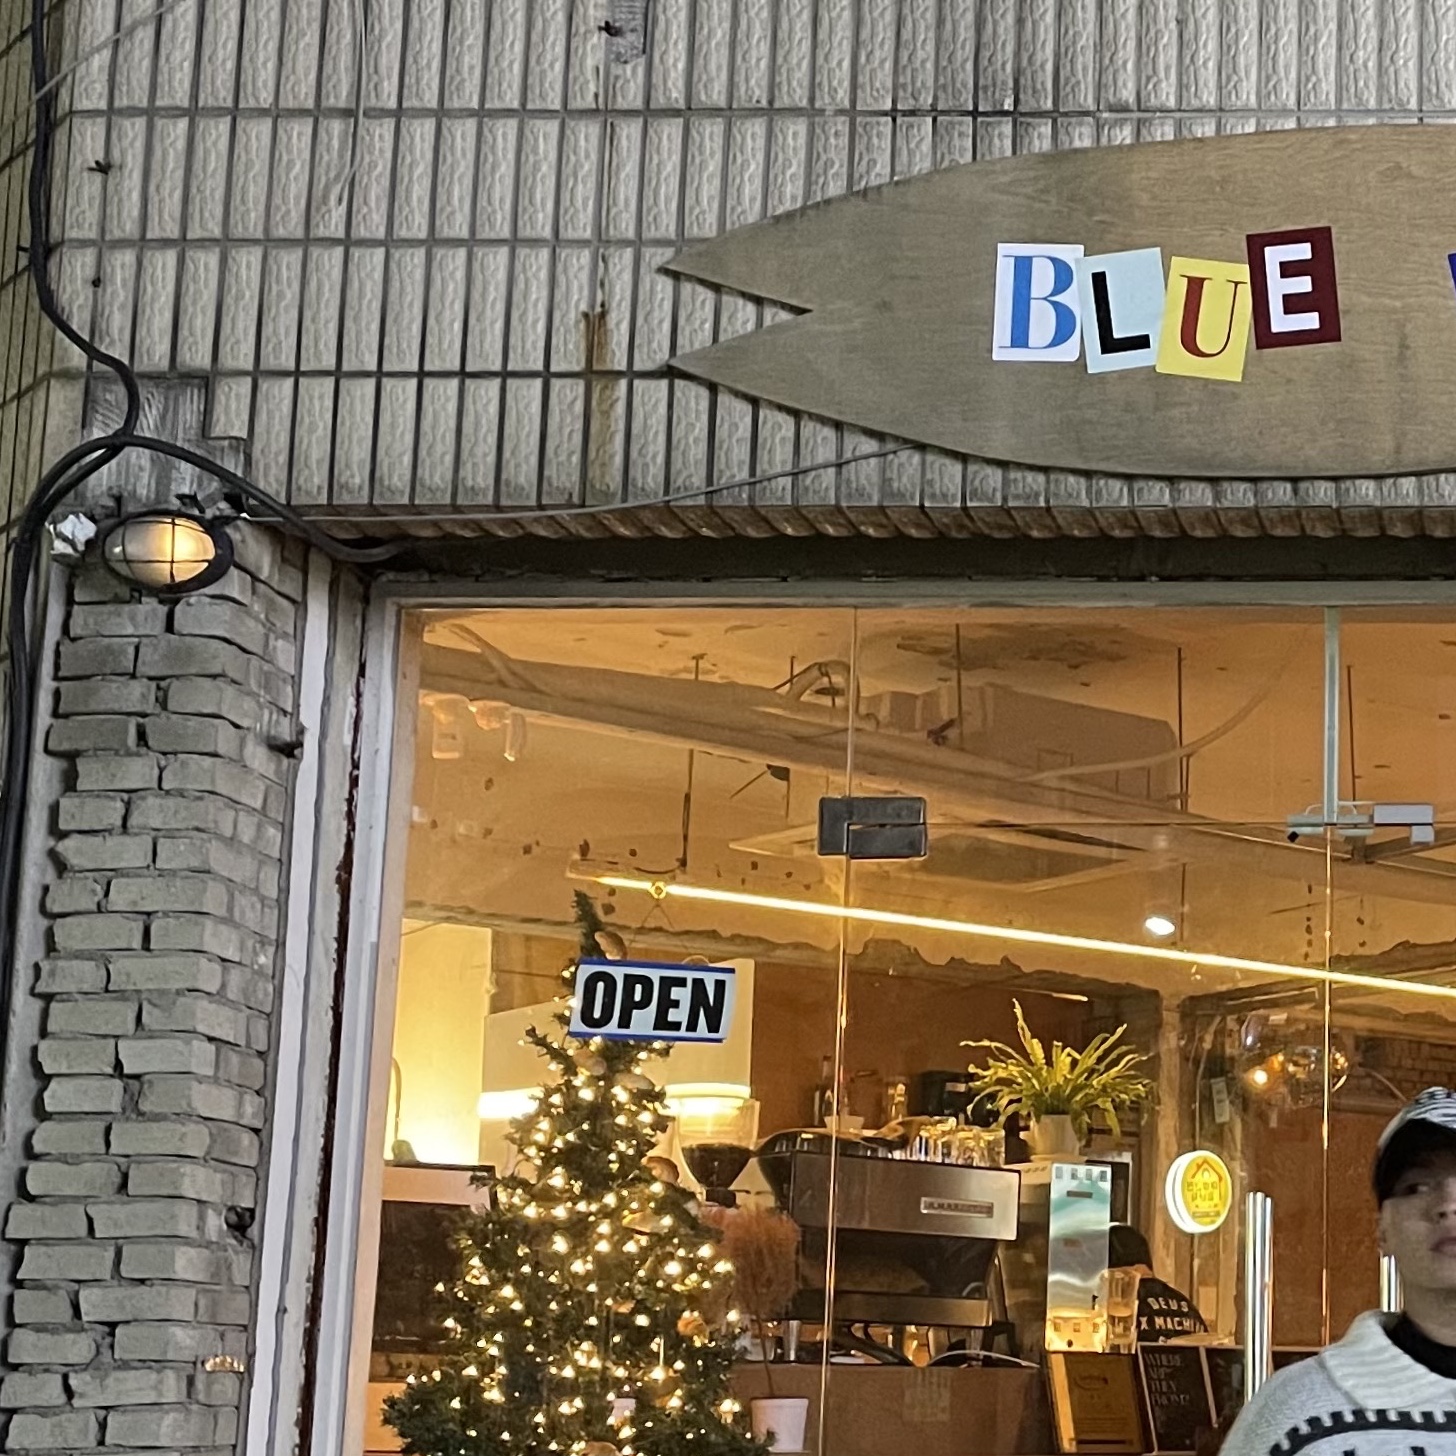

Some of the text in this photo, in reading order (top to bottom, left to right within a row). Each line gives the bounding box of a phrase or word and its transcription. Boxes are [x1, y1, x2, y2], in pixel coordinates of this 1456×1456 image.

[998, 242, 1320, 359] BLUE
[580, 970, 727, 1034] OPEN
[1147, 1297, 1189, 1312] DEUS
